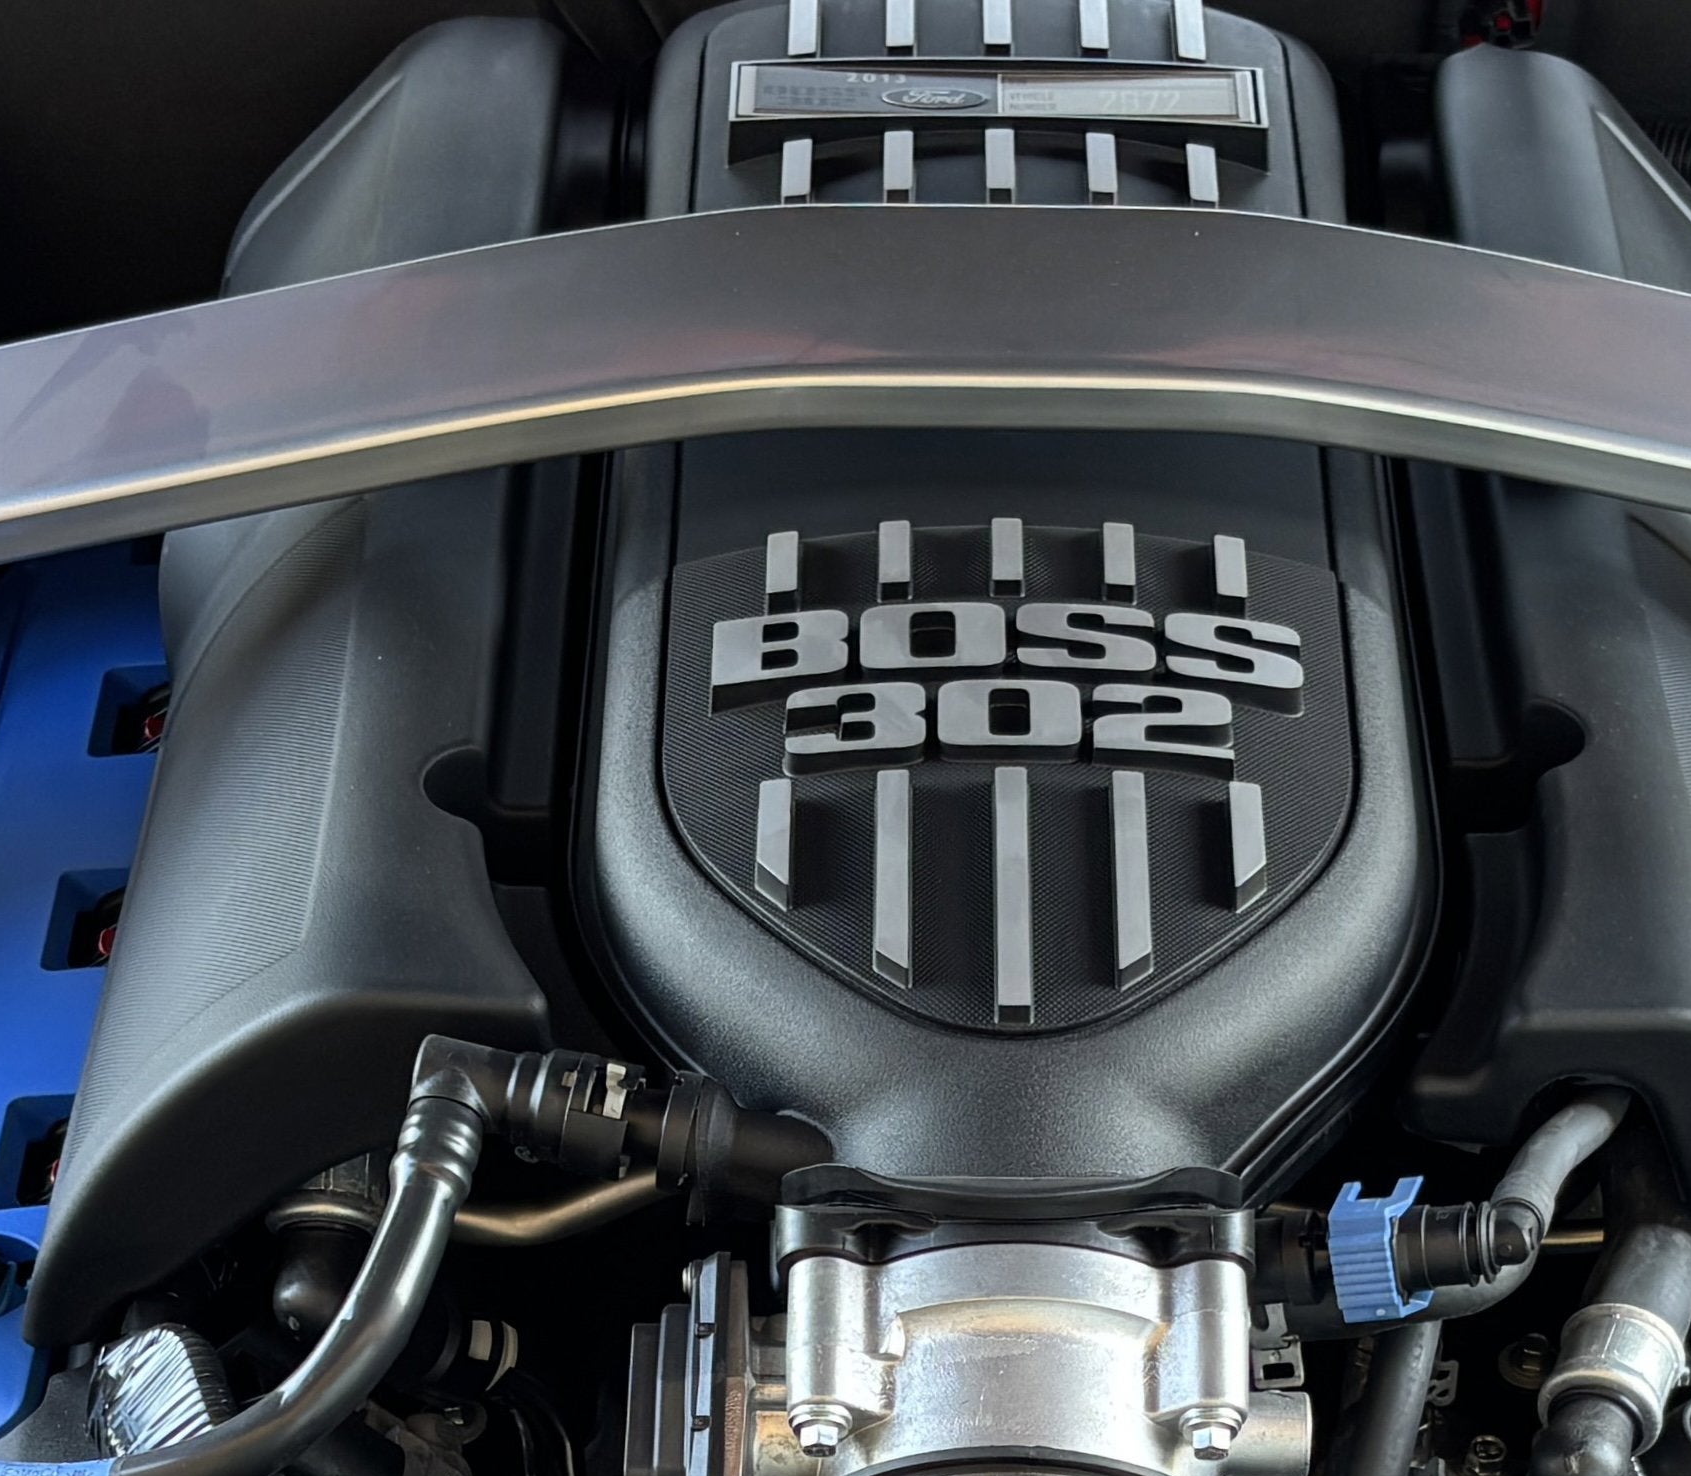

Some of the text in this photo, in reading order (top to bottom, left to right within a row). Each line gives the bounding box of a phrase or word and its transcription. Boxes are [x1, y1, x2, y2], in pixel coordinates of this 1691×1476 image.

[846, 72, 909, 85] 2013
[710, 601, 1305, 708] BOSS
[783, 679, 1236, 772] 302
